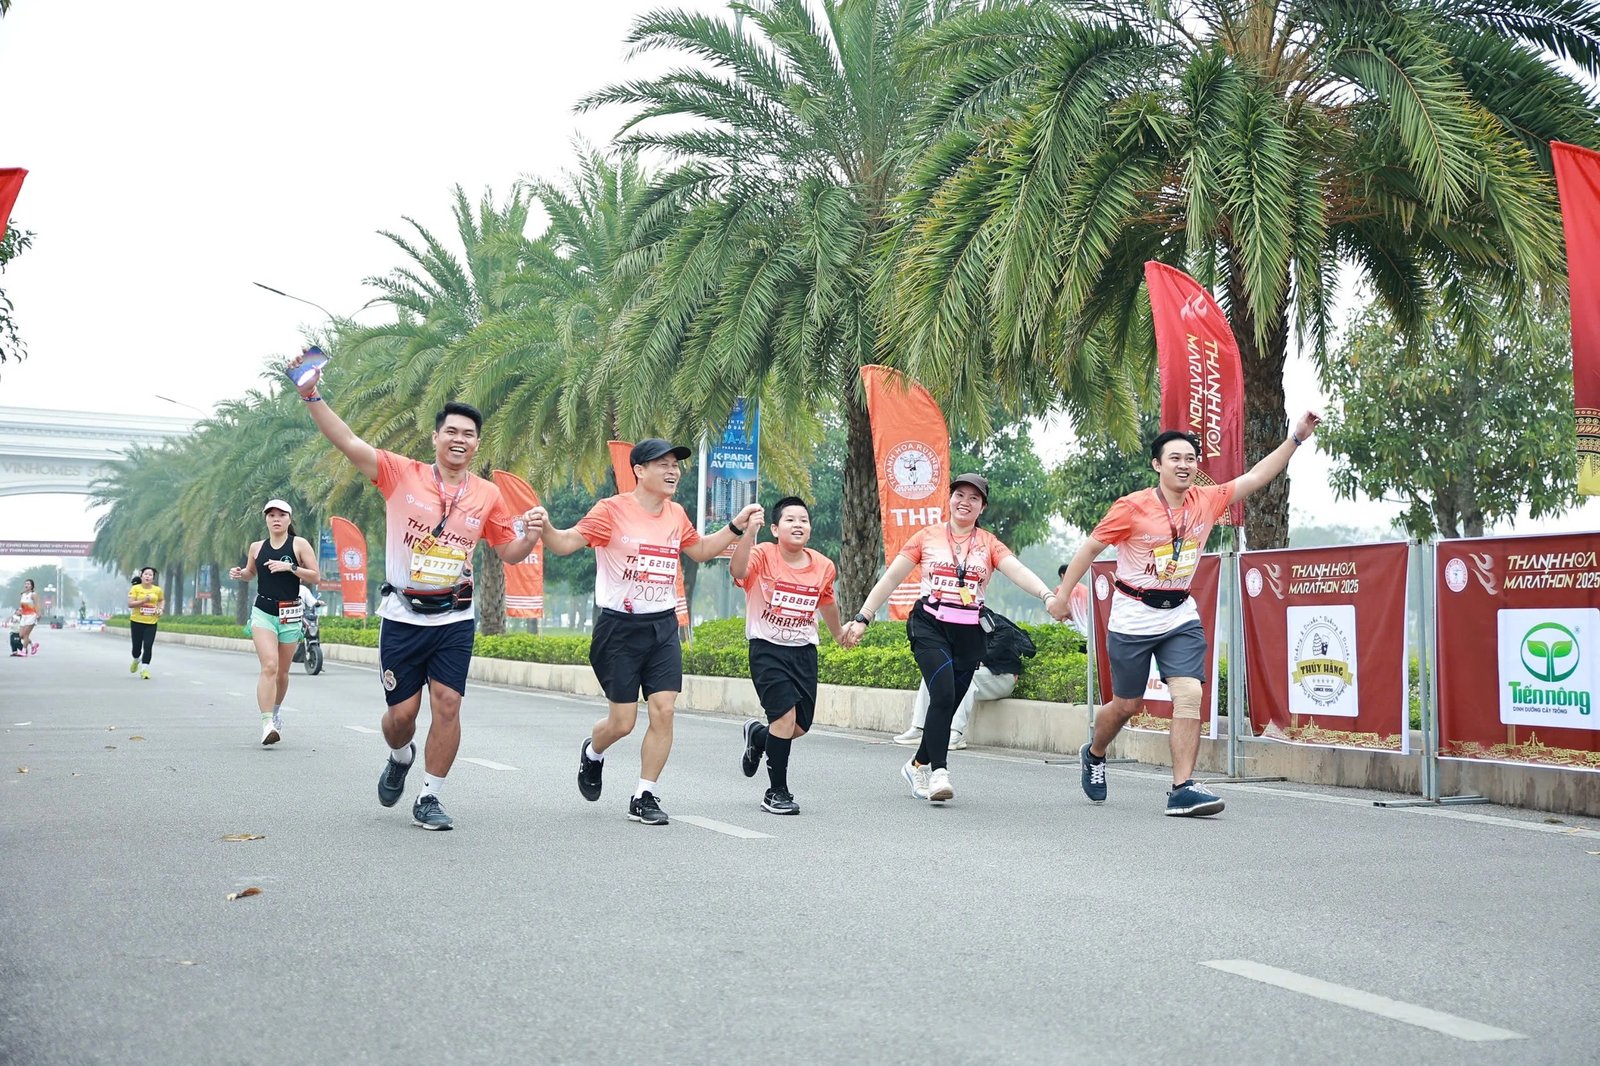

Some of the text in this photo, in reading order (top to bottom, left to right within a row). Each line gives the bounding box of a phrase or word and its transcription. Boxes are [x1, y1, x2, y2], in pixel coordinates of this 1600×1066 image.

[1186, 333, 1203, 429] MARATHON
[1204, 340, 1221, 413] THANH
[3, 463, 80, 476] VINHOMES
[711, 461, 754, 470] AVENUE
[886, 454, 898, 486] THANH
[916, 444, 939, 485] RUNNERS
[890, 506, 942, 527] THR
[407, 517, 449, 541] THAH
[423, 559, 459, 570] 87777
[1507, 552, 1561, 570] THANH
[343, 572, 365, 580] THR
[1291, 563, 1331, 578] THANH
[1288, 579, 1359, 594] MARATHON 2025
[1503, 572, 1600, 589] MARATHON 2025
